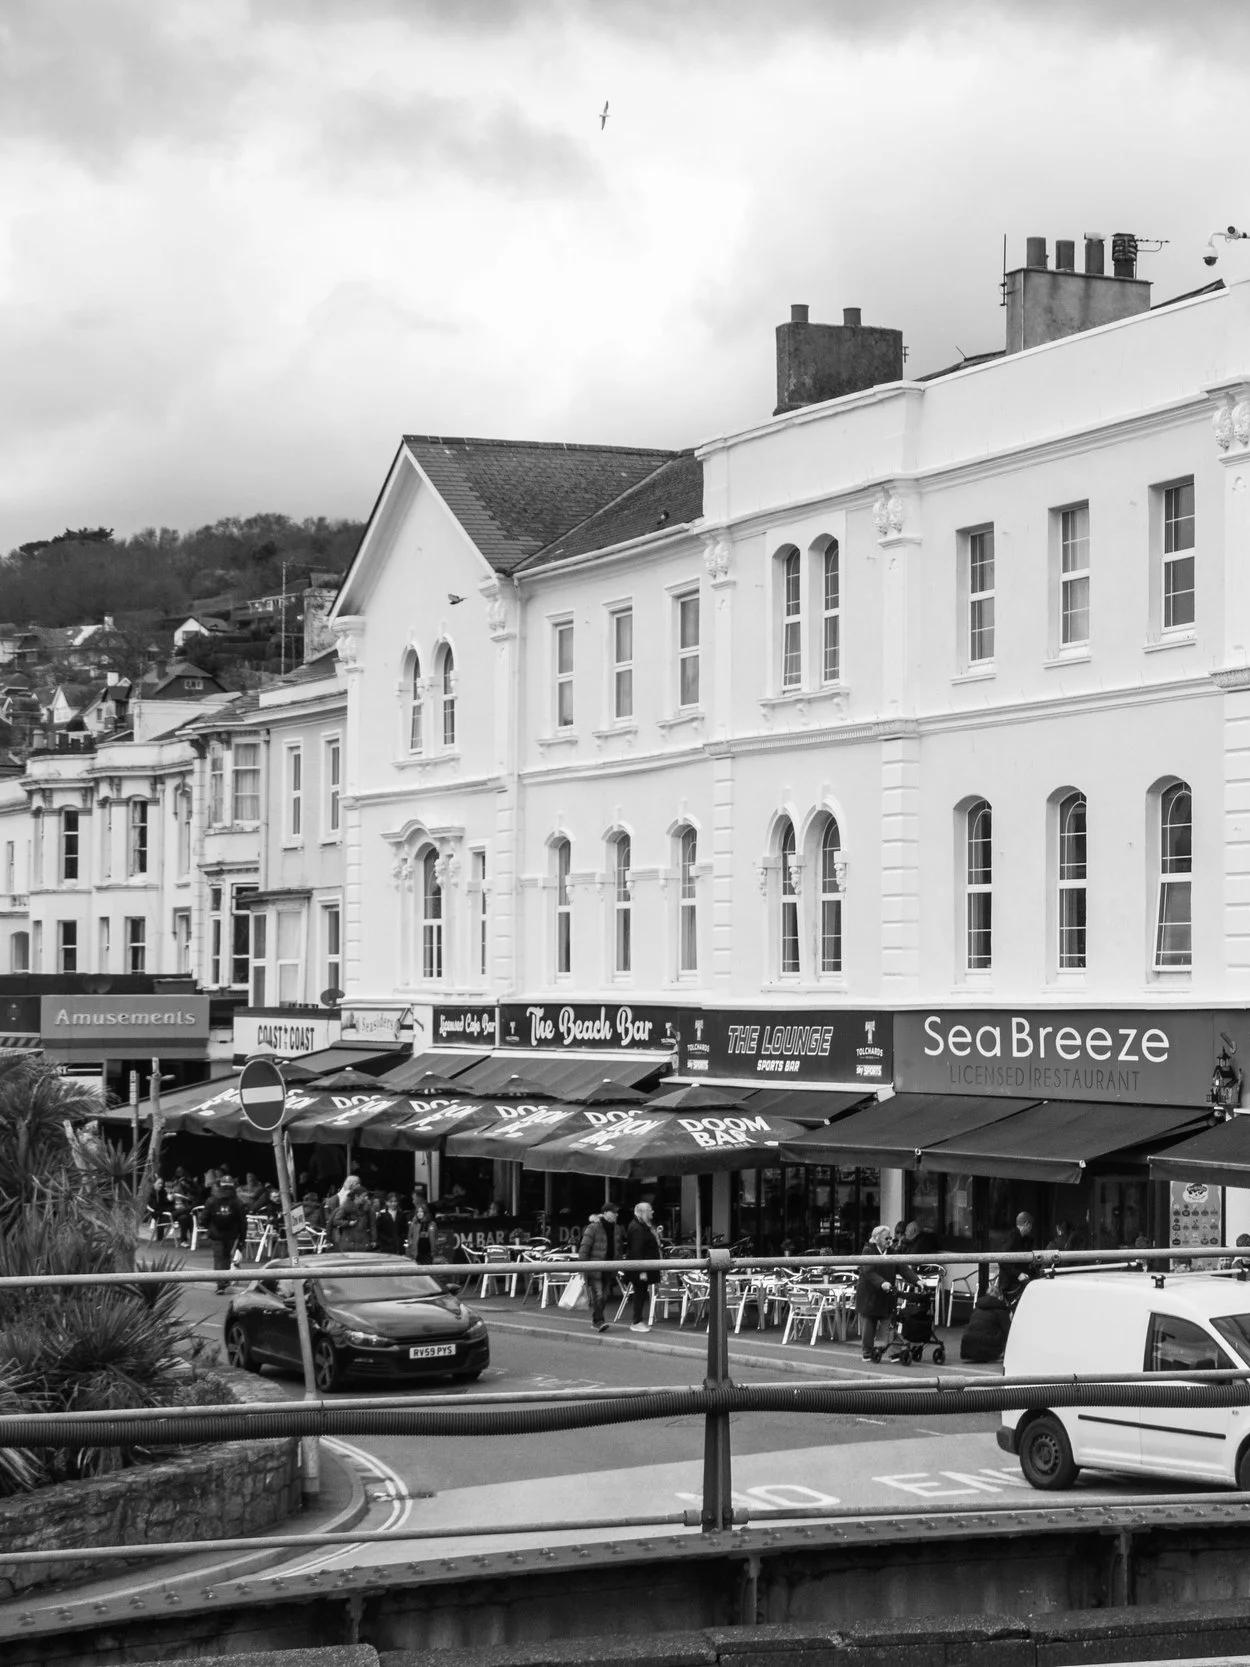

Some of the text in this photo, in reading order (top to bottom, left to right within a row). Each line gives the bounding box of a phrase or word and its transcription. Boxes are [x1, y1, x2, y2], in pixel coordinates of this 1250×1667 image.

[54, 1009, 196, 1025] Amusements
[482, 1013, 495, 1036] Bar
[526, 1006, 653, 1046] The Beach Bar
[258, 1025, 283, 1049] COAST
[290, 1027, 315, 1051] COAST
[727, 1025, 834, 1056] THE LOUNGE
[856, 1047, 884, 1058] TOLCHARDS
[756, 1059, 801, 1073] SPORTS BAR
[863, 1065, 883, 1077] SPORTS
[949, 1065, 1140, 1092] LICENSED RESTAURANT
[676, 1115, 772, 1132] DOOM
[690, 1131, 757, 1148] BAR
[476, 1231, 506, 1247] BAR
[436, 1345, 453, 1355] PYS
